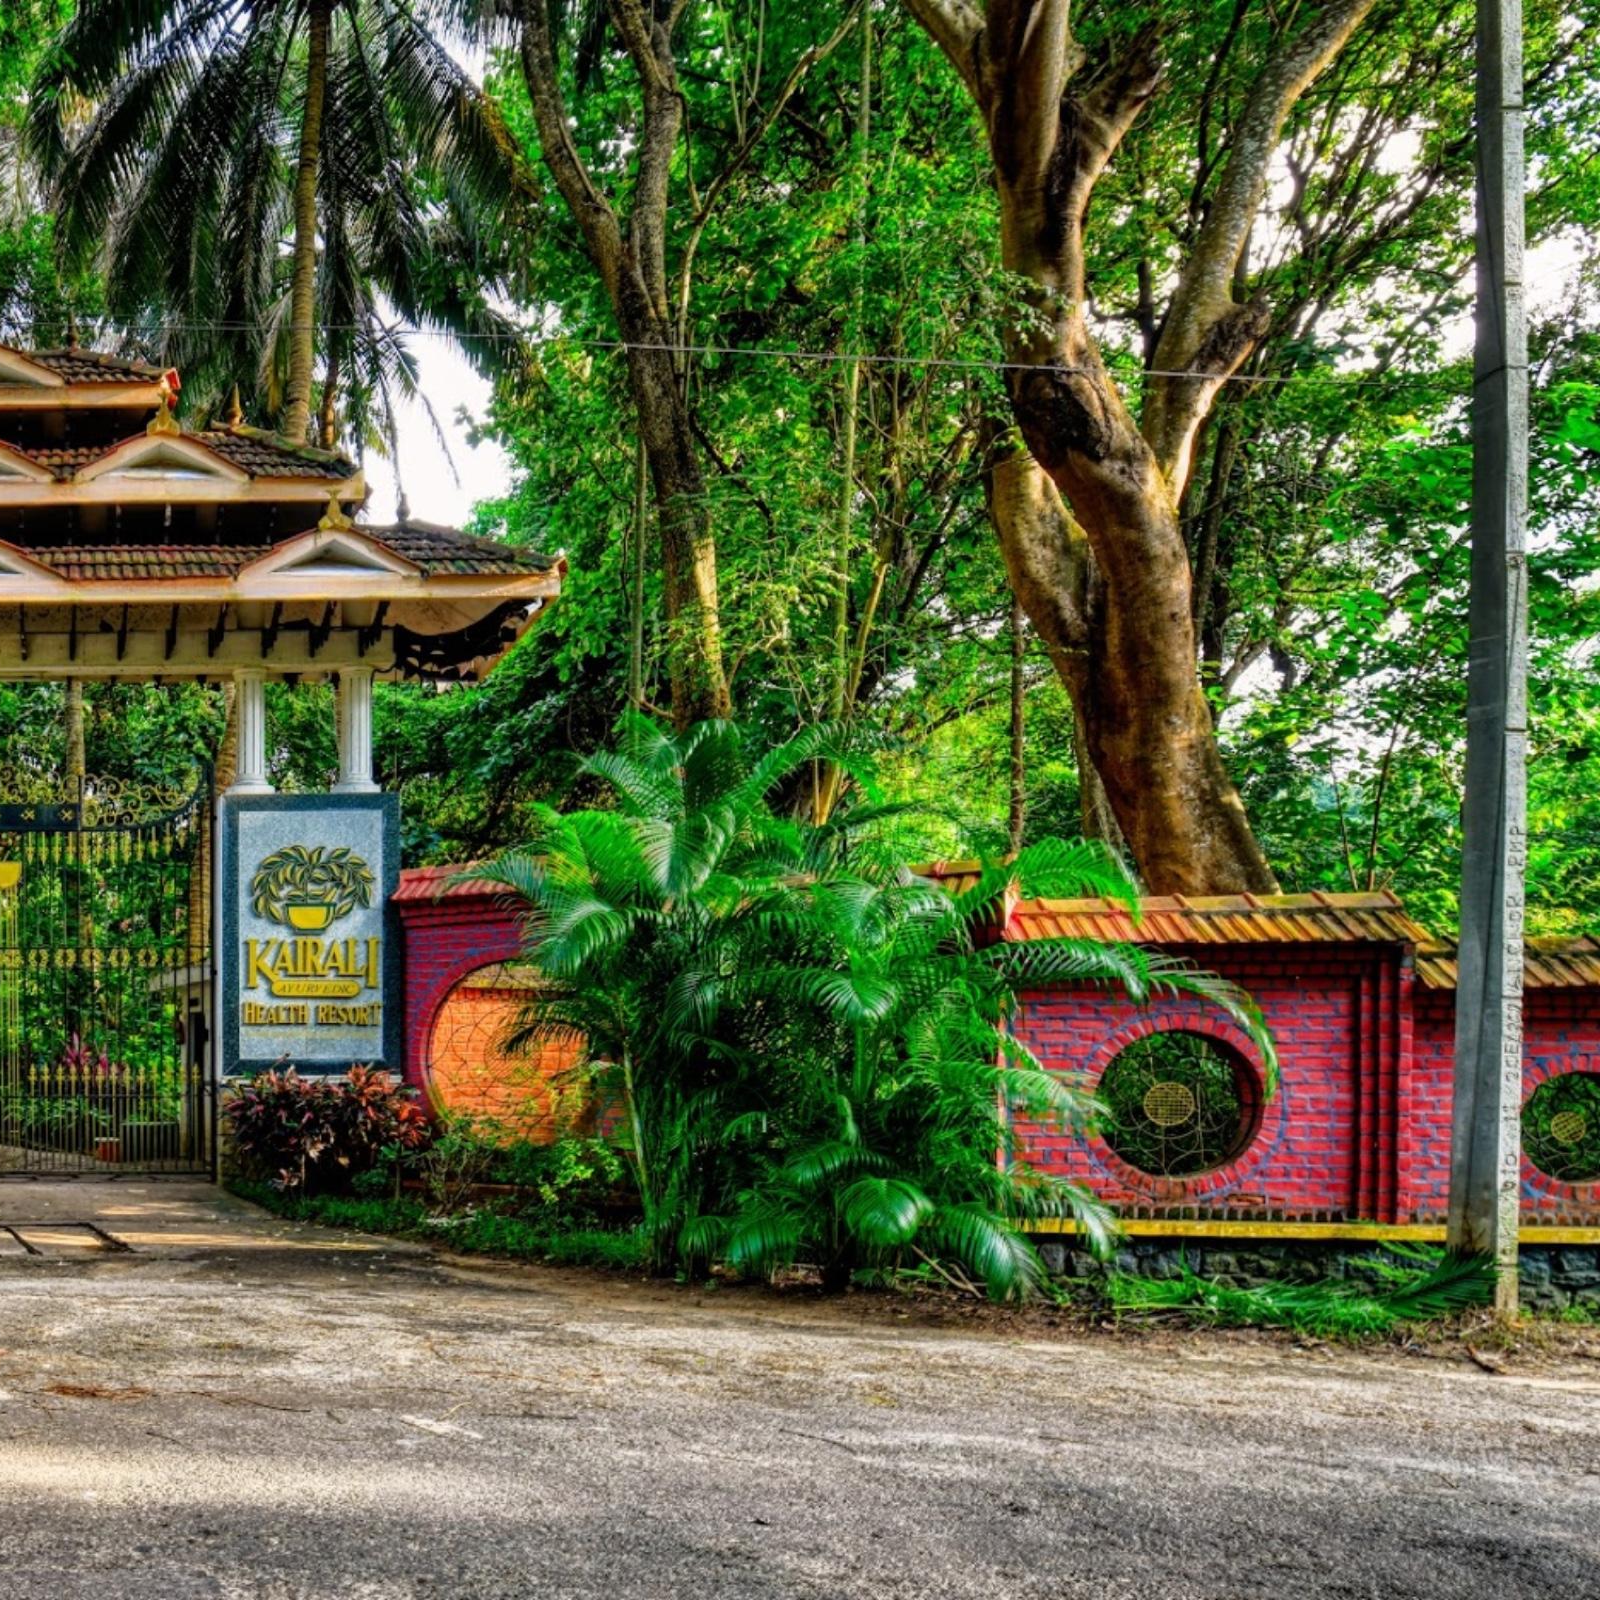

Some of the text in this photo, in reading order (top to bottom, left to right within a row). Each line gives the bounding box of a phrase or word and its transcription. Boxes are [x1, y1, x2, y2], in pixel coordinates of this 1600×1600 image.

[245, 936, 380, 989] KAIRALI
[278, 983, 352, 994] AYURVEDIC
[243, 1002, 383, 1026] HEALTH RESORT
